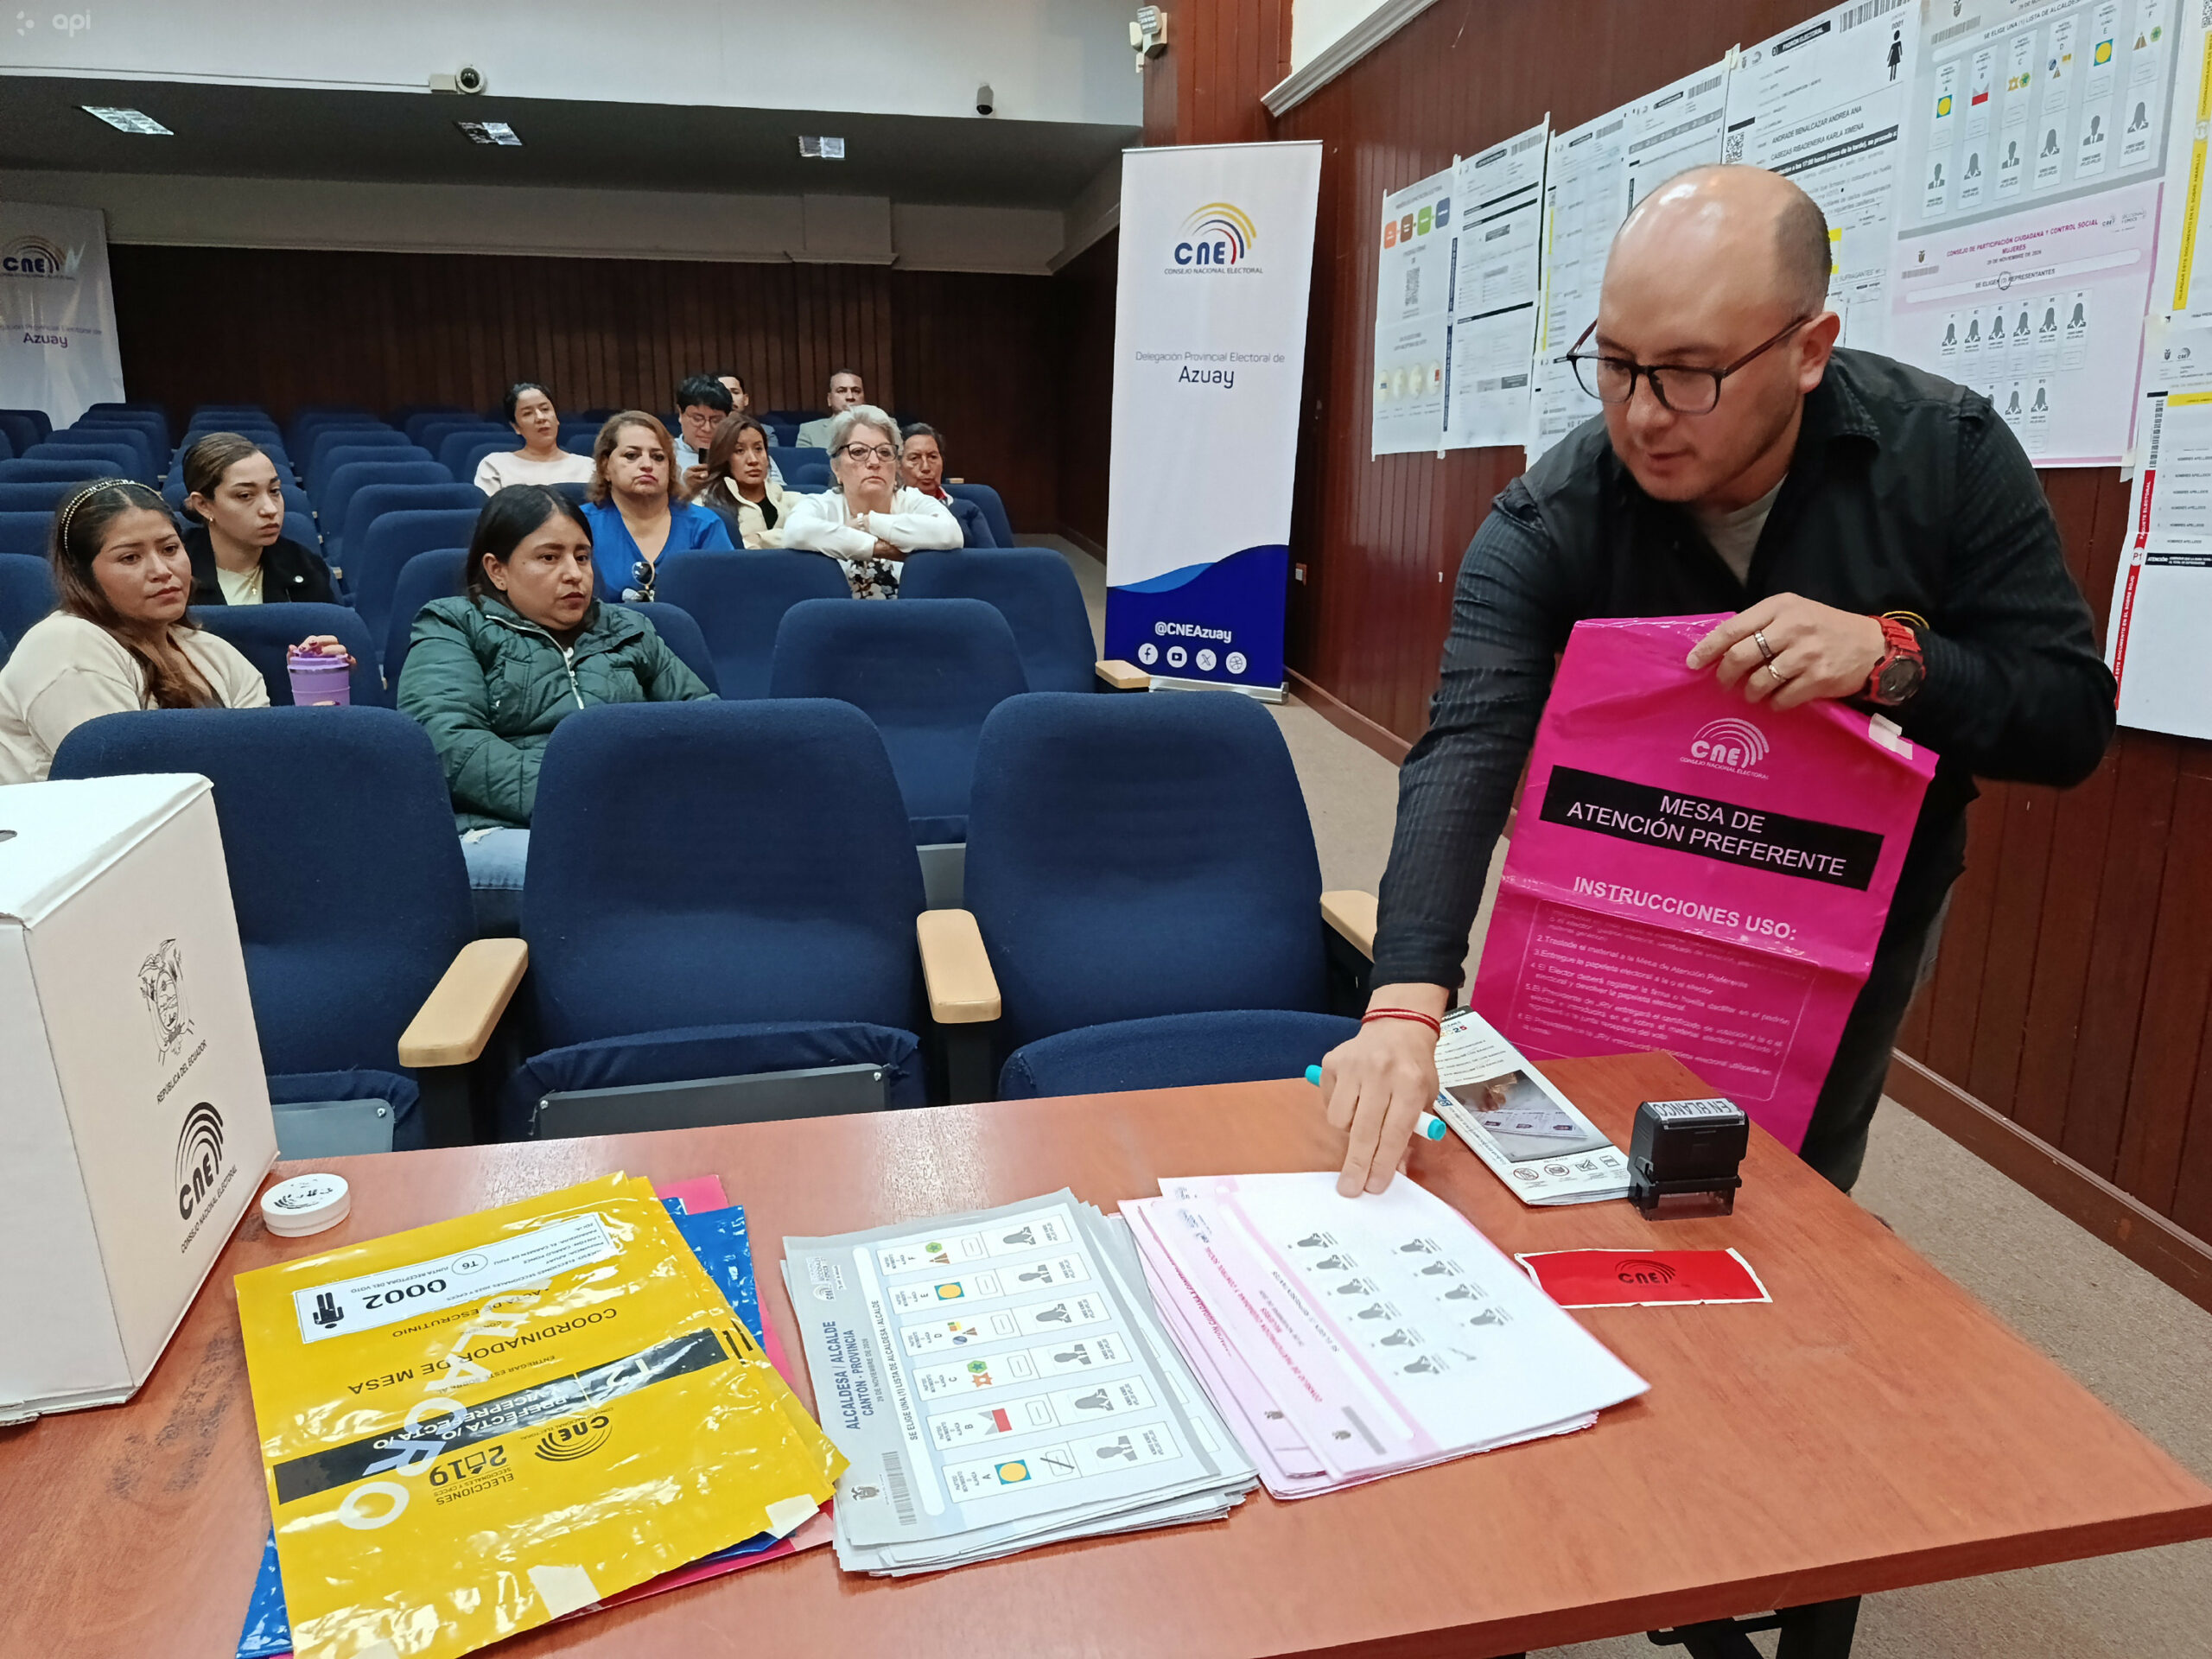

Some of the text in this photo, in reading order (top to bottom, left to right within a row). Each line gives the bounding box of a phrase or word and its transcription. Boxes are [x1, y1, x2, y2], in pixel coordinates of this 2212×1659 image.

[2078, 219, 2098, 229] SOCIAL
[1174, 241, 1225, 265] CNE
[23, 332, 68, 348] Azuay
[1135, 352, 1285, 364] Delegación Provincial Electoral de
[1179, 365, 1235, 389] Azuay
[1154, 621, 1232, 644] @CNEAzuay
[1690, 739, 1742, 767] CNE
[1660, 795, 1766, 833] MESA DE
[1567, 801, 1847, 877] ATENCIÓN PREFERENTE
[1572, 875, 1797, 941] INSTRUCCIONES USO:
[157, 1040, 207, 1103] REPÚBLICA DEL ECUADOR
[1654, 1101, 1732, 1116] EN BLANCO
[179, 1152, 214, 1221] CNE
[181, 1166, 237, 1253] CONSEJO NACIONAL ELECTORAL
[386, 1273, 425, 1285] RECEPTORA
[462, 1261, 478, 1270] T6
[364, 1280, 446, 1309] 0002
[392, 1289, 541, 1338] ACTA DE ESCRUTINIO
[871, 1300, 884, 1325] ALCALDE
[349, 1309, 616, 1394] COORDINADOR DE MESA
[823, 1322, 843, 1363] ALCALDE
[843, 1331, 862, 1373] PROVINCIA
[880, 1328, 894, 1361] ALCALDESA
[508, 1356, 555, 1372] ENTREGAR
[892, 1370, 903, 1388] LISTA
[835, 1371, 860, 1429] ALCALDESA
[855, 1381, 874, 1415] CANTÓN
[899, 1396, 909, 1410] UNA
[463, 1393, 567, 1433] PREFECTA
[903, 1412, 915, 1429] ELIGE
[558, 1413, 610, 1443] CNE
[908, 1431, 918, 1440] SE
[436, 1473, 513, 1504] ELECCIONES
[465, 1467, 512, 1486] SECCIONALES
[434, 1485, 457, 1497] CPCCS
